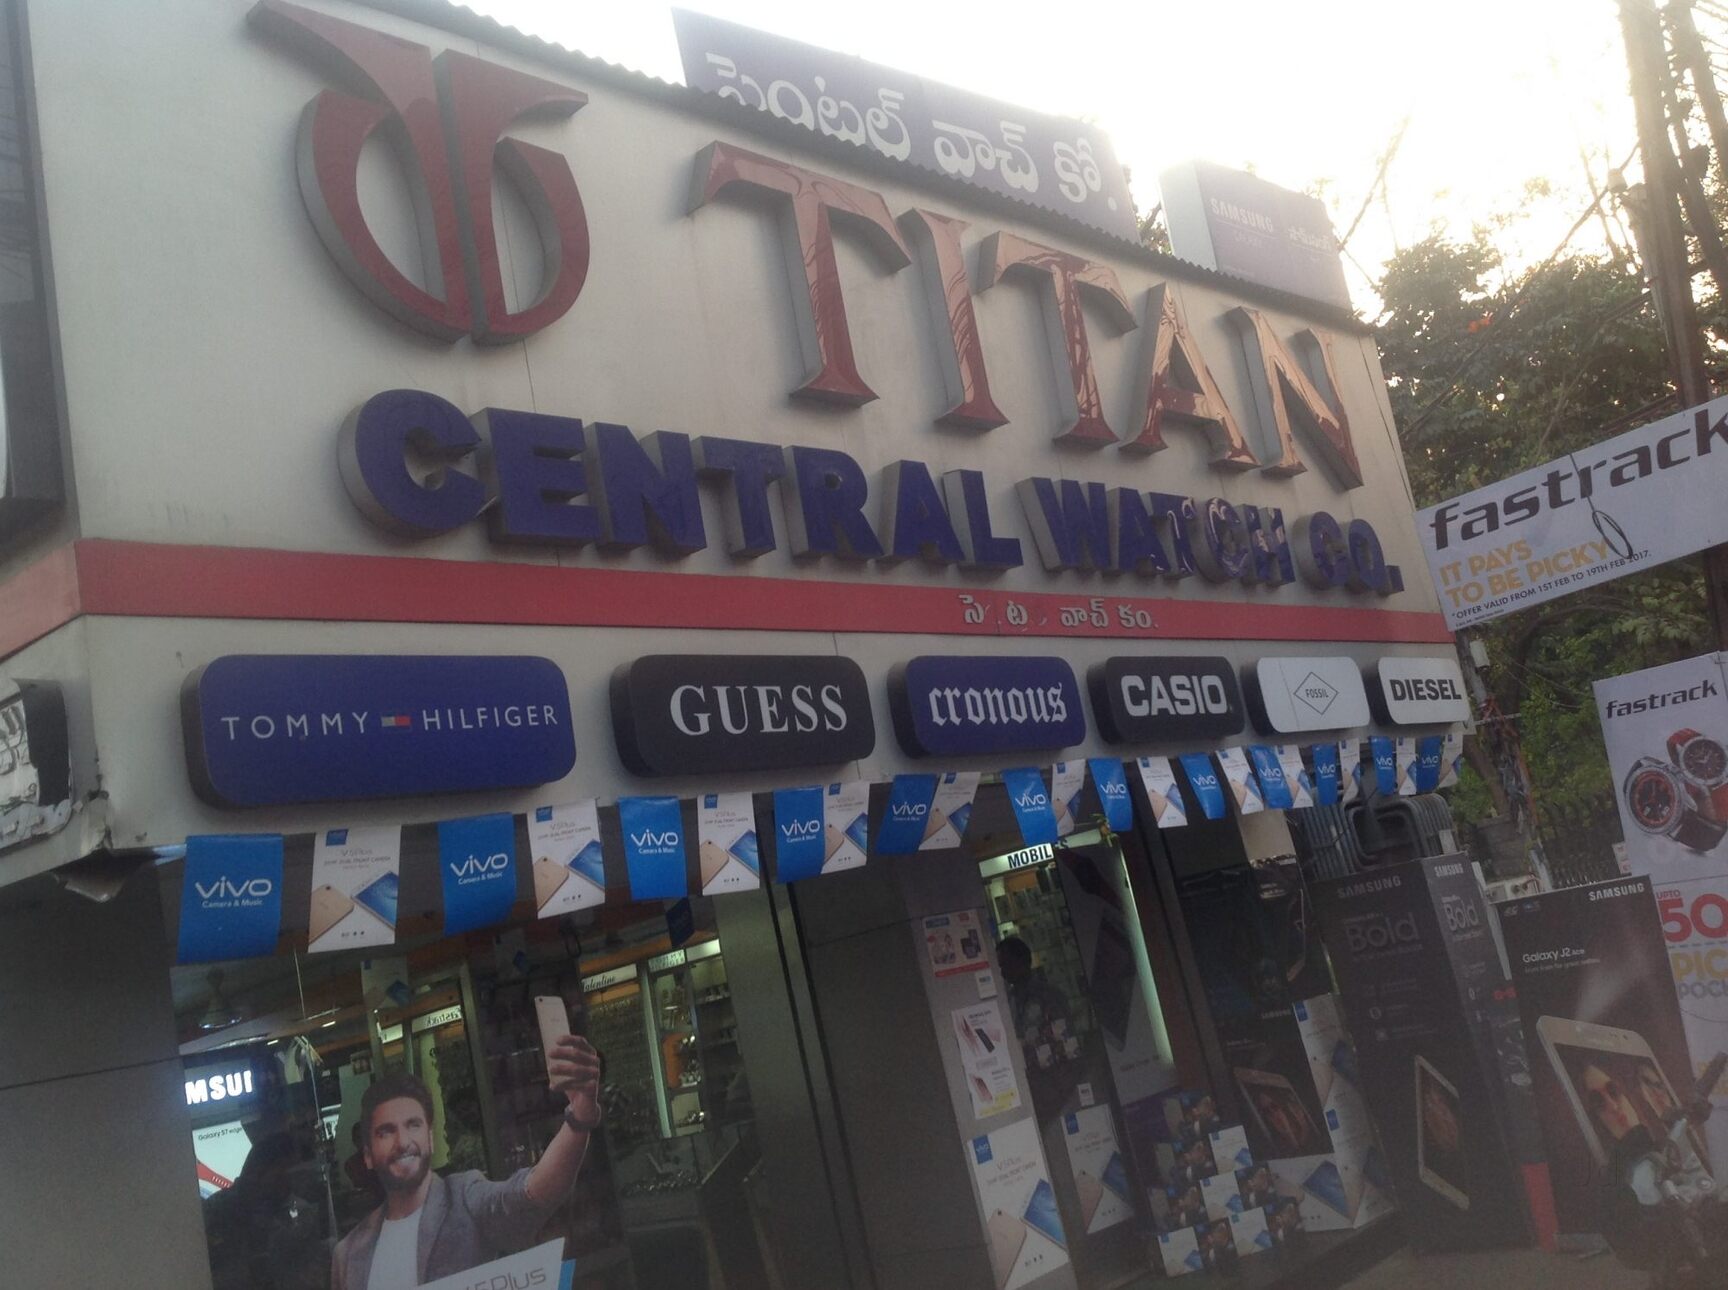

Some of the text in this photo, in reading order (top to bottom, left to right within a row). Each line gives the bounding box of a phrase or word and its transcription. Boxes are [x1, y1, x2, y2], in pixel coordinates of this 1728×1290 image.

[1210, 198, 1274, 232] SAMSUNG
[690, 140, 1364, 488] TITAN
[340, 388, 1025, 568] CENTRAL
[1016, 476, 1296, 587] WATCH
[1429, 409, 1728, 551] fastrack
[1440, 539, 1532, 586] IT PAYS
[1445, 538, 1610, 608] TO BE PICKY
[1484, 596, 1508, 610] VALID
[1510, 586, 1536, 602] FROM
[1537, 581, 1553, 594] 1ST
[1554, 575, 1570, 589] FEB
[1572, 571, 1583, 583] TO
[1586, 564, 1607, 578] 19TH
[1609, 557, 1626, 570] FEB
[1120, 674, 1228, 717] CASIO
[1305, 687, 1330, 699] FOSSIL
[1390, 678, 1462, 701] DIESEL
[1606, 679, 1718, 719] fastrack
[669, 684, 848, 737] GUESS
[928, 683, 1068, 727] cronous
[221, 705, 559, 741] TOMMY HILFIGER
[1317, 764, 1337, 776] vivo
[1375, 756, 1394, 768] vivo
[1421, 754, 1440, 766] vivo
[1100, 782, 1127, 794] vivo
[1193, 774, 1217, 787] vivo
[892, 801, 927, 815] vivo
[1015, 793, 1047, 807] vivo
[631, 829, 678, 847] vivo
[781, 819, 820, 836] vivo
[450, 854, 508, 876] vivo
[1434, 864, 1464, 877] SAMSUNG
[194, 875, 272, 899] vivo
[1338, 875, 1402, 898] SAMSUNG
[1588, 883, 1645, 901] SAMSUNG
[202, 900, 232, 909] Camera
[1444, 900, 1479, 931] Bold
[1658, 894, 1728, 942] 50
[1345, 911, 1420, 951] Bold
[1522, 949, 1558, 963] Galaxy
[1560, 947, 1575, 957] J2
